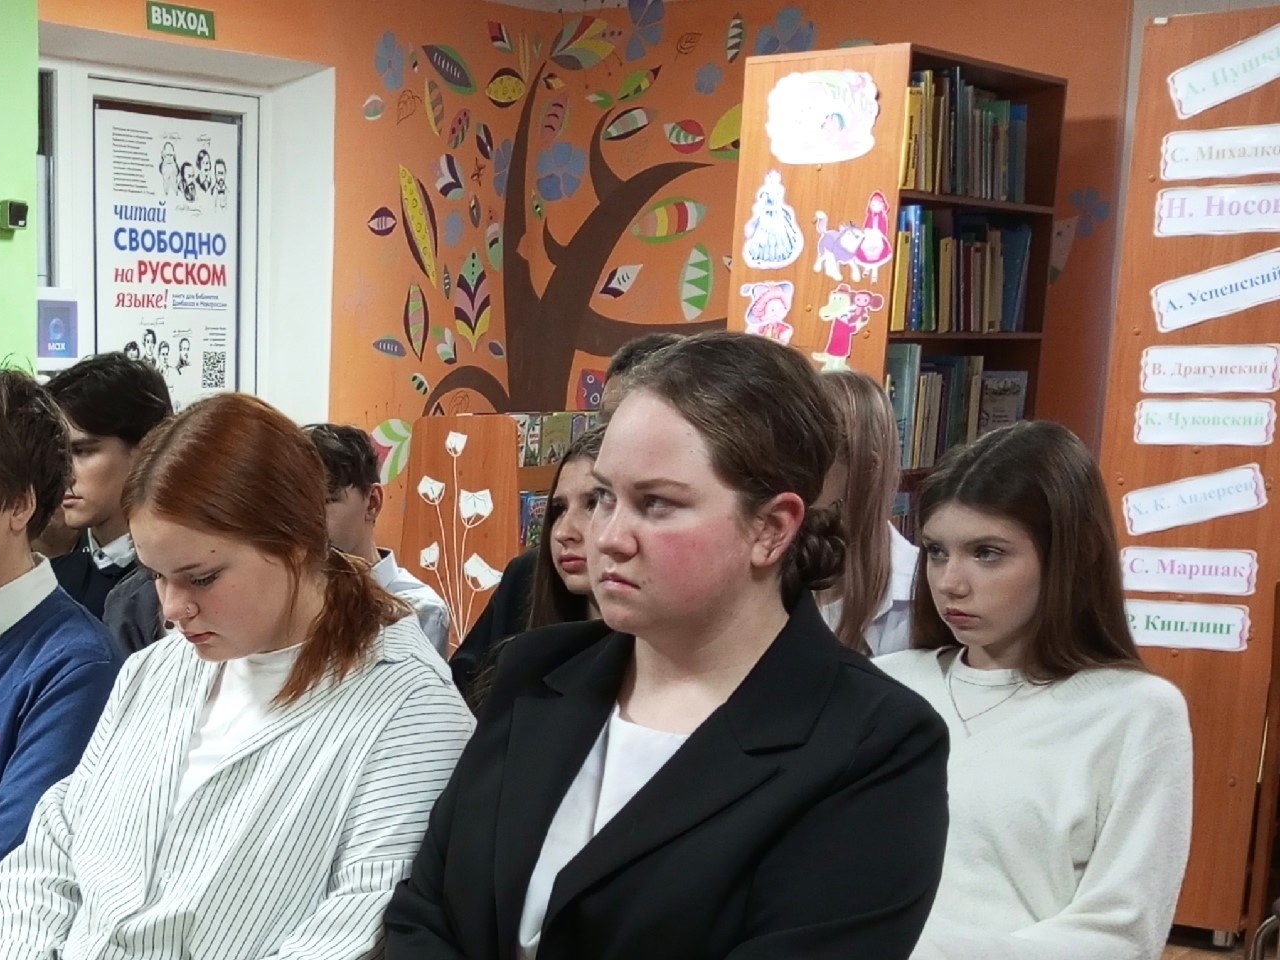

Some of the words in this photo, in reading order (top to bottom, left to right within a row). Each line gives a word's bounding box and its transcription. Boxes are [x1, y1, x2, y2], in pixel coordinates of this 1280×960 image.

[151, 5, 209, 36] ВЫХОД
[1170, 149, 1189, 163] С.
[113, 201, 167, 223] читай
[1166, 197, 1193, 219] Н.
[113, 227, 227, 260] СВОБОДНО
[114, 267, 134, 283] на
[137, 260, 228, 287] РУССКОМ
[114, 288, 169, 310] языке!
[1165, 299, 1183, 313] А.
[1187, 266, 1280, 306] Успенский
[1152, 362, 1167, 376] В.
[1170, 361, 1269, 379] Драгунский
[1144, 412, 1162, 426] К.
[1168, 411, 1265, 430] Чуковский
[1153, 499, 1171, 512] К.
[1128, 557, 1150, 574] С.
[1156, 558, 1246, 580] Маршак
[1145, 614, 1236, 636] Киплинг
